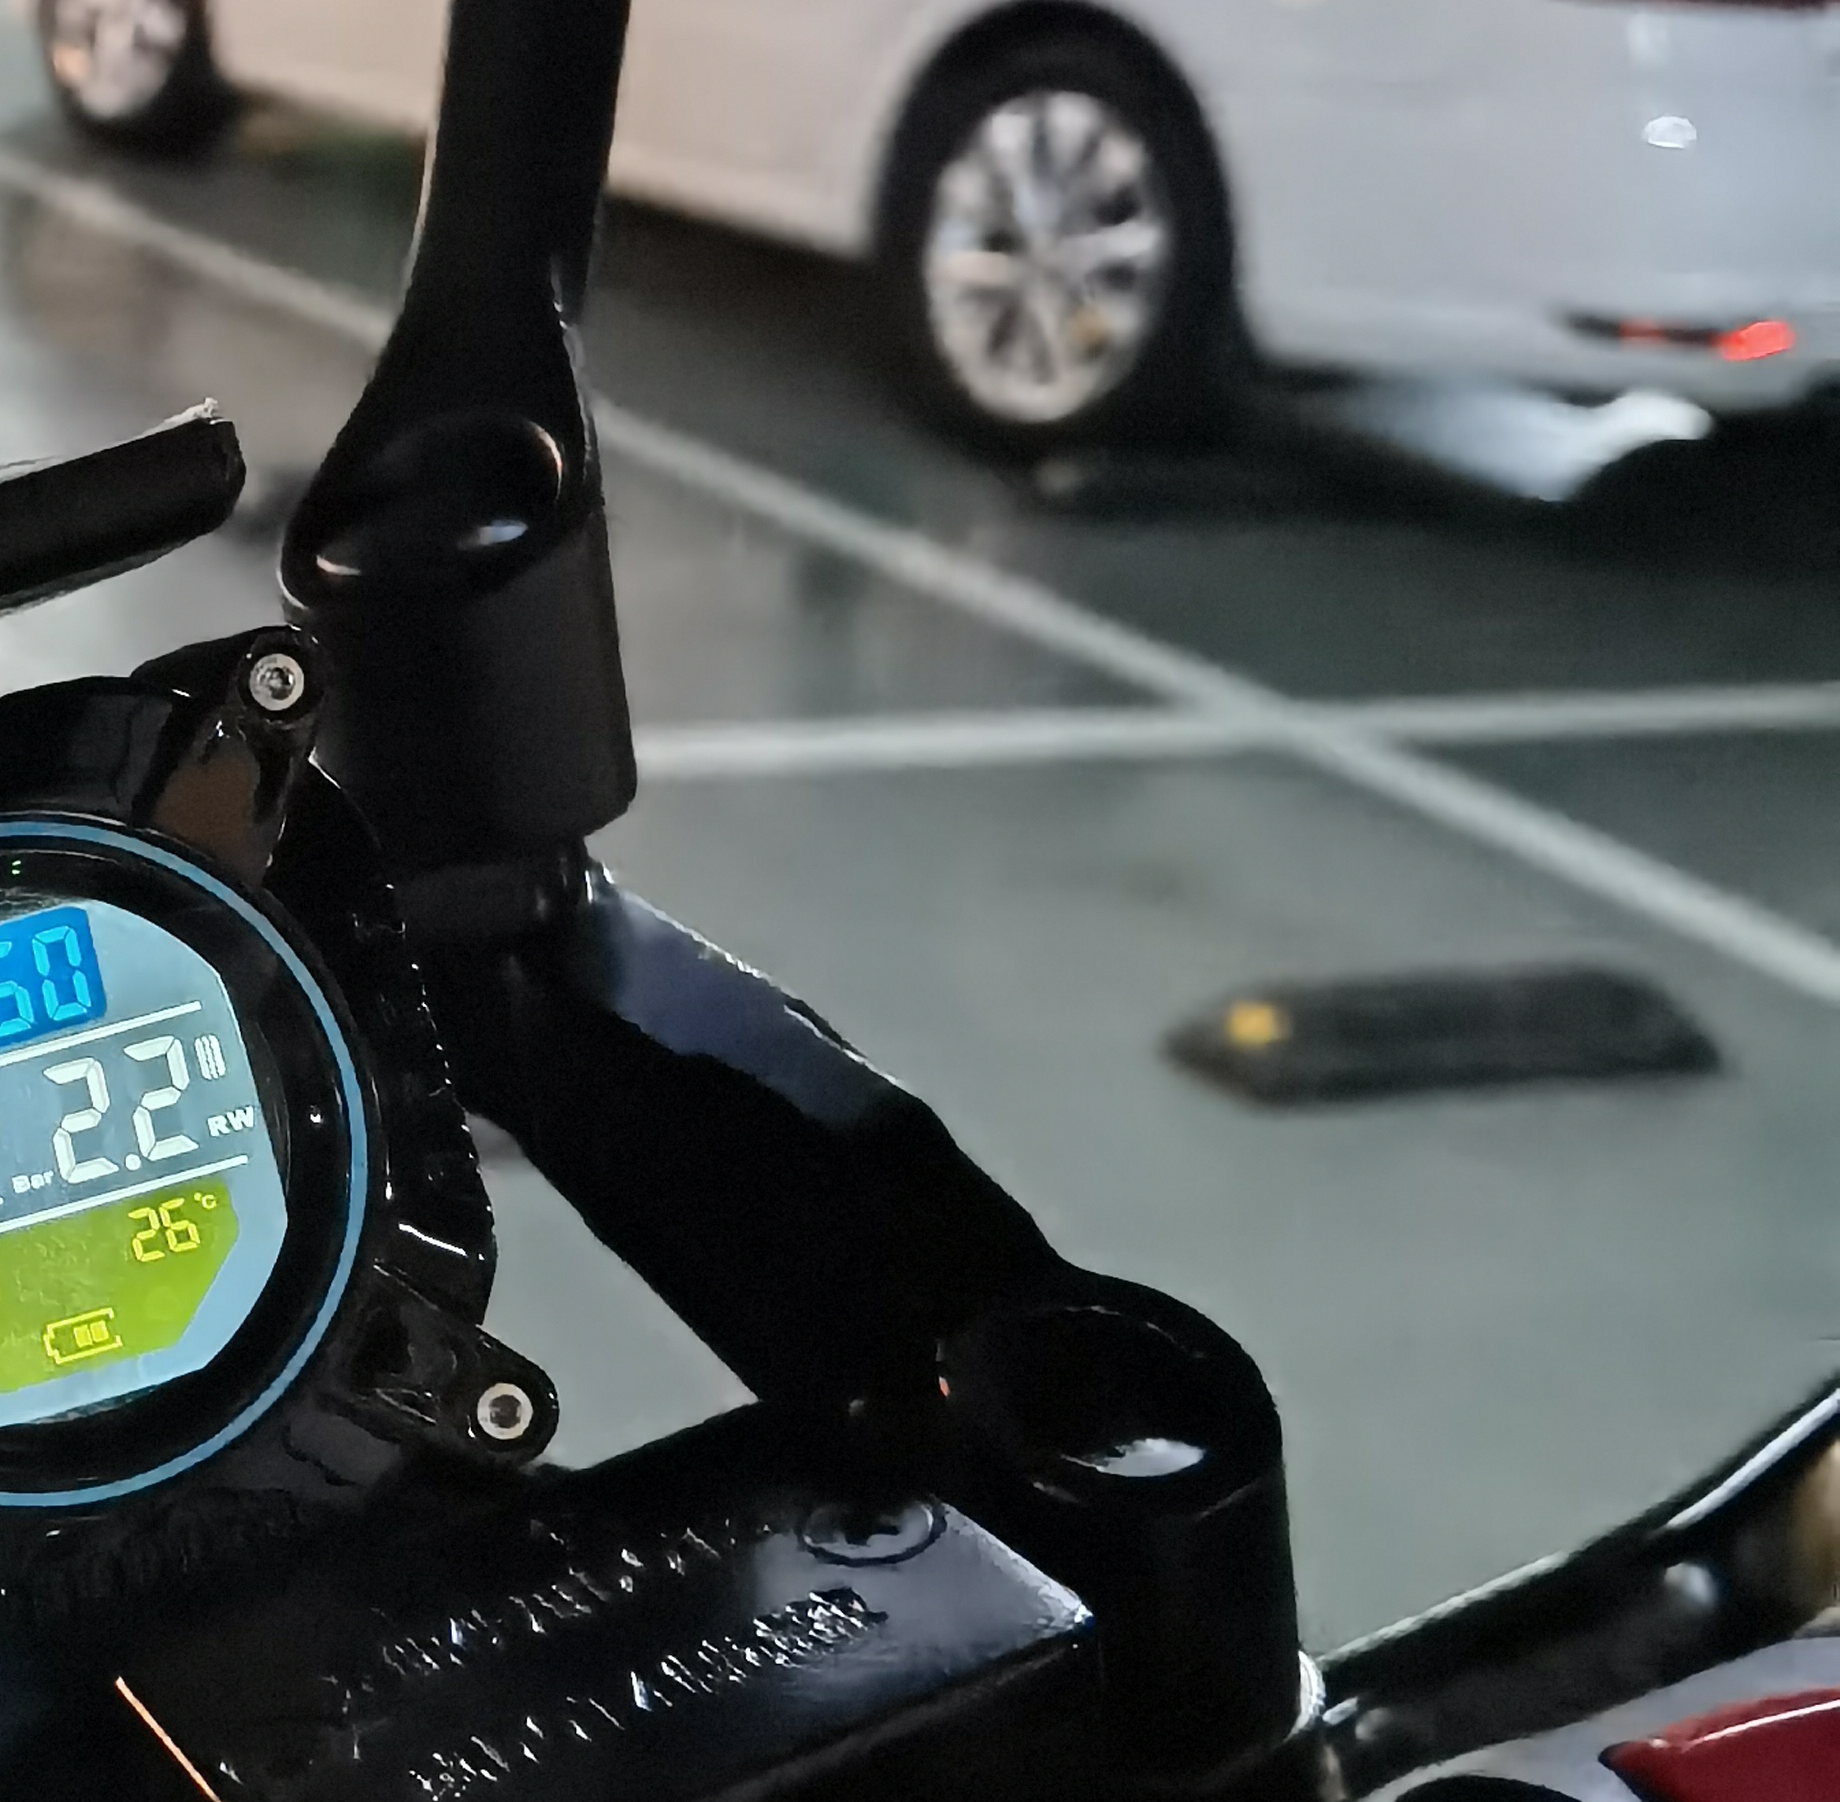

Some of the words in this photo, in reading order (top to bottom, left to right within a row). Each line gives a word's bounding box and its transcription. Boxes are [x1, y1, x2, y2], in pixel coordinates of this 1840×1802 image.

[11, 1171, 54, 1194] Bar
[42, 1035, 200, 1184] 2.2
[207, 1106, 255, 1137] RW
